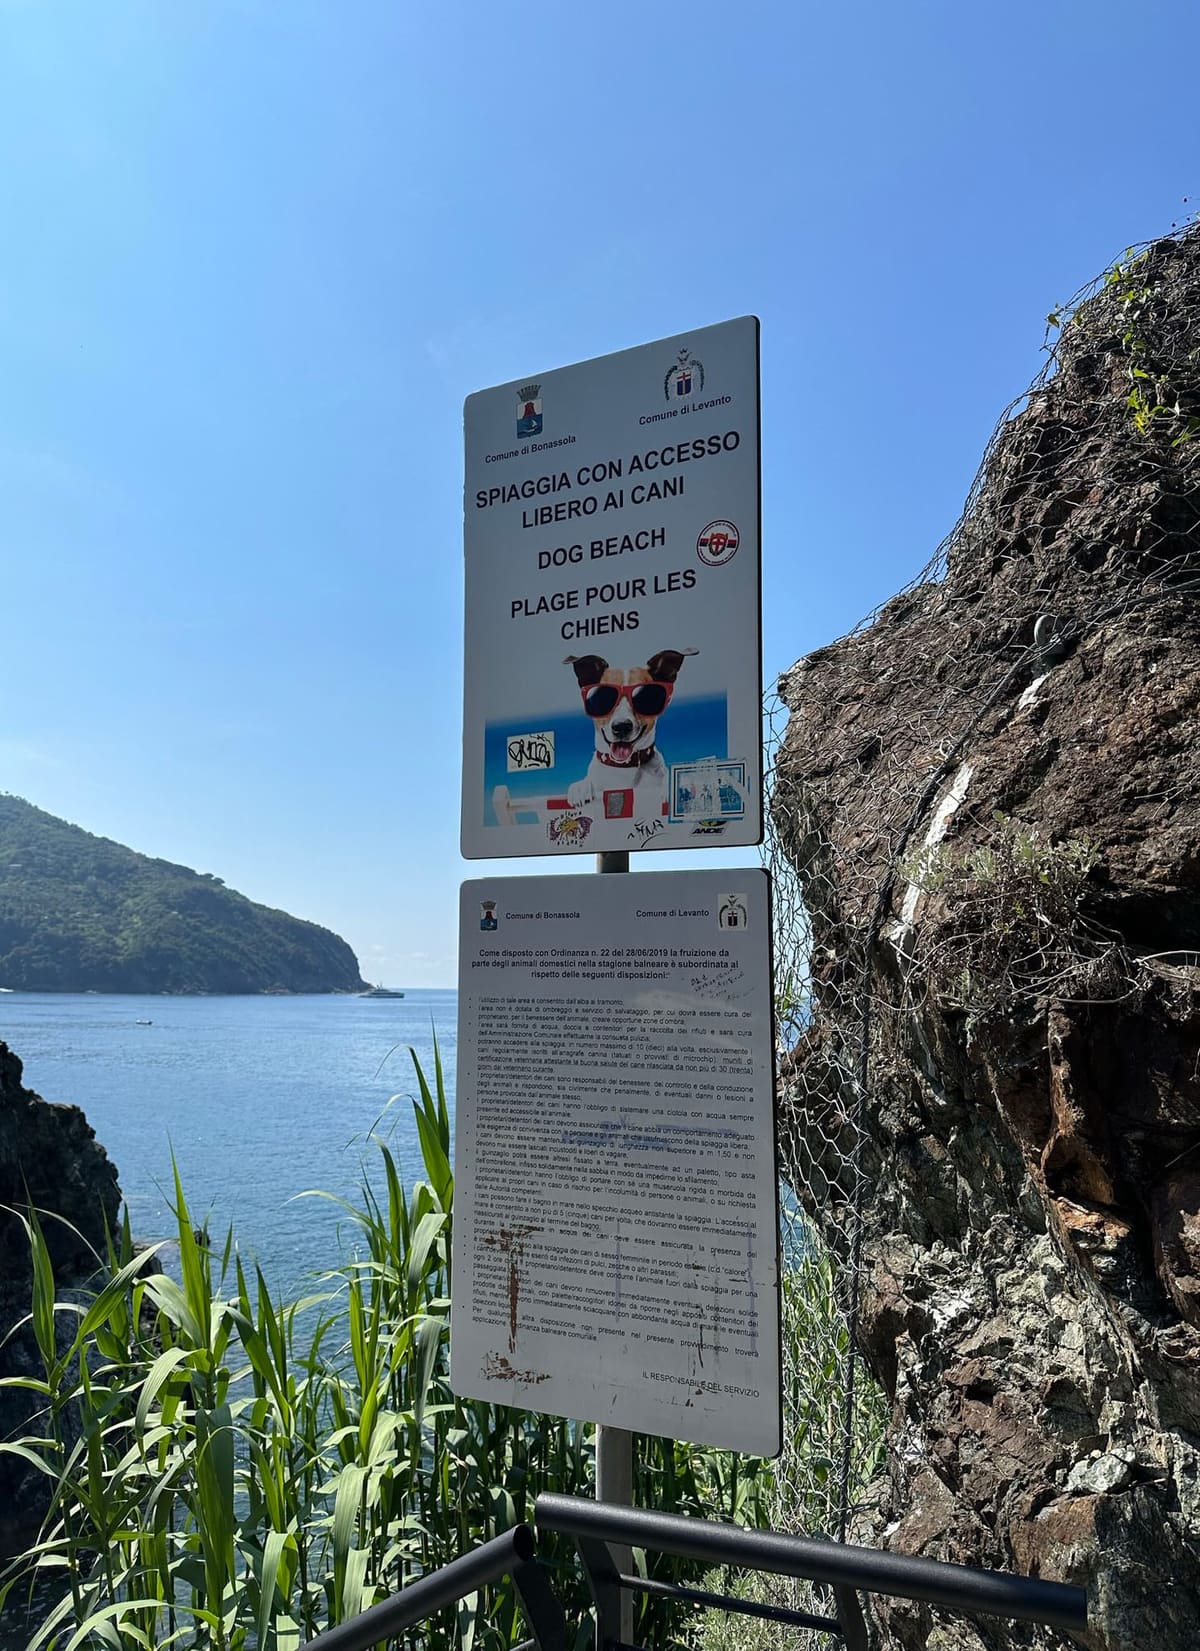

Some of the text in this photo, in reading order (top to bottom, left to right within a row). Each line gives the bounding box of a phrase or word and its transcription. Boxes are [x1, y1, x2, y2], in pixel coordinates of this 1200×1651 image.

[639, 395, 731, 425] Comune di Levanto
[485, 435, 576, 464] Comune di Bonassola
[476, 431, 740, 508] SPIAGGIA CON ACCESSO
[522, 476, 684, 528] LIBERO AI CANI
[538, 544, 582, 570] DOG
[591, 528, 665, 560] BEACH
[512, 568, 696, 618] PLAGE POUR LES
[561, 611, 640, 640] CHIENS
[505, 910, 580, 920] Comune di Bonassola
[636, 909, 709, 918] Comune di Levanto
[479, 949, 500, 957] Come
[501, 948, 533, 959] disposto
[550, 949, 589, 957] Ordinanza
[612, 948, 624, 956] del
[626, 948, 668, 957] 28/06/2019
[670, 948, 677, 956] la
[679, 948, 716, 956] fruizione
[718, 948, 729, 956] da
[471, 959, 738, 970] parte degli animali domestici nella stagione balneare è subordinata al
[531, 970, 560, 980] rispetto
[561, 970, 580, 979] delle
[582, 971, 615, 980] seguenti
[582, 1005, 604, 1013] servizio
[612, 1015, 642, 1025] opportune
[649, 1025, 674, 1034] raccolta
[664, 1080, 692, 1089] controllo
[699, 1082, 715, 1091] della
[716, 1083, 754, 1093] conduzione
[724, 1093, 746, 1102] lesioni
[562, 1101, 581, 1109] hanno
[619, 1105, 649, 1114] sistemare
[667, 1108, 688, 1117] ciotola
[705, 1112, 726, 1121] acqua
[729, 1114, 755, 1123] sempre
[672, 1127, 722, 1140] comportamento
[723, 1131, 755, 1142] adeguato
[667, 1145, 697, 1157] superiore
[684, 1137, 700, 1146] della
[701, 1138, 729, 1150] spiaggia
[573, 1155, 594, 1164] fissato
[624, 1160, 669, 1171] eventualmente
[696, 1166, 721, 1178] paletto,
[740, 1170, 756, 1179] asta
[617, 1168, 634, 1177] modo
[590, 1175, 612, 1186] portare
[688, 1184, 707, 1195] rigida
[717, 1187, 744, 1197] morbida
[547, 1181, 756, 1208] caso rischio persone richiesta
[490, 1193, 514, 1203] possono
[532, 1196, 552, 1207] bagno
[591, 1203, 619, 1214] specchio
[620, 1207, 643, 1217] acqueo
[494, 1201, 757, 1238] consentito dovranno immediatamente
[660, 1238, 694, 1250] assicurata
[710, 1246, 741, 1257] presenza
[559, 1254, 631, 1271] infezioni zecche
[658, 1257, 684, 1270] periodo
[700, 1282, 729, 1295] spiaggia
[539, 1316, 576, 1331] disposizione
[630, 1311, 669, 1324] abbondante
[541, 1326, 567, 1337] balneare
[643, 1370, 760, 1398] IL RESPONSABILE DEL SERVIZIO
